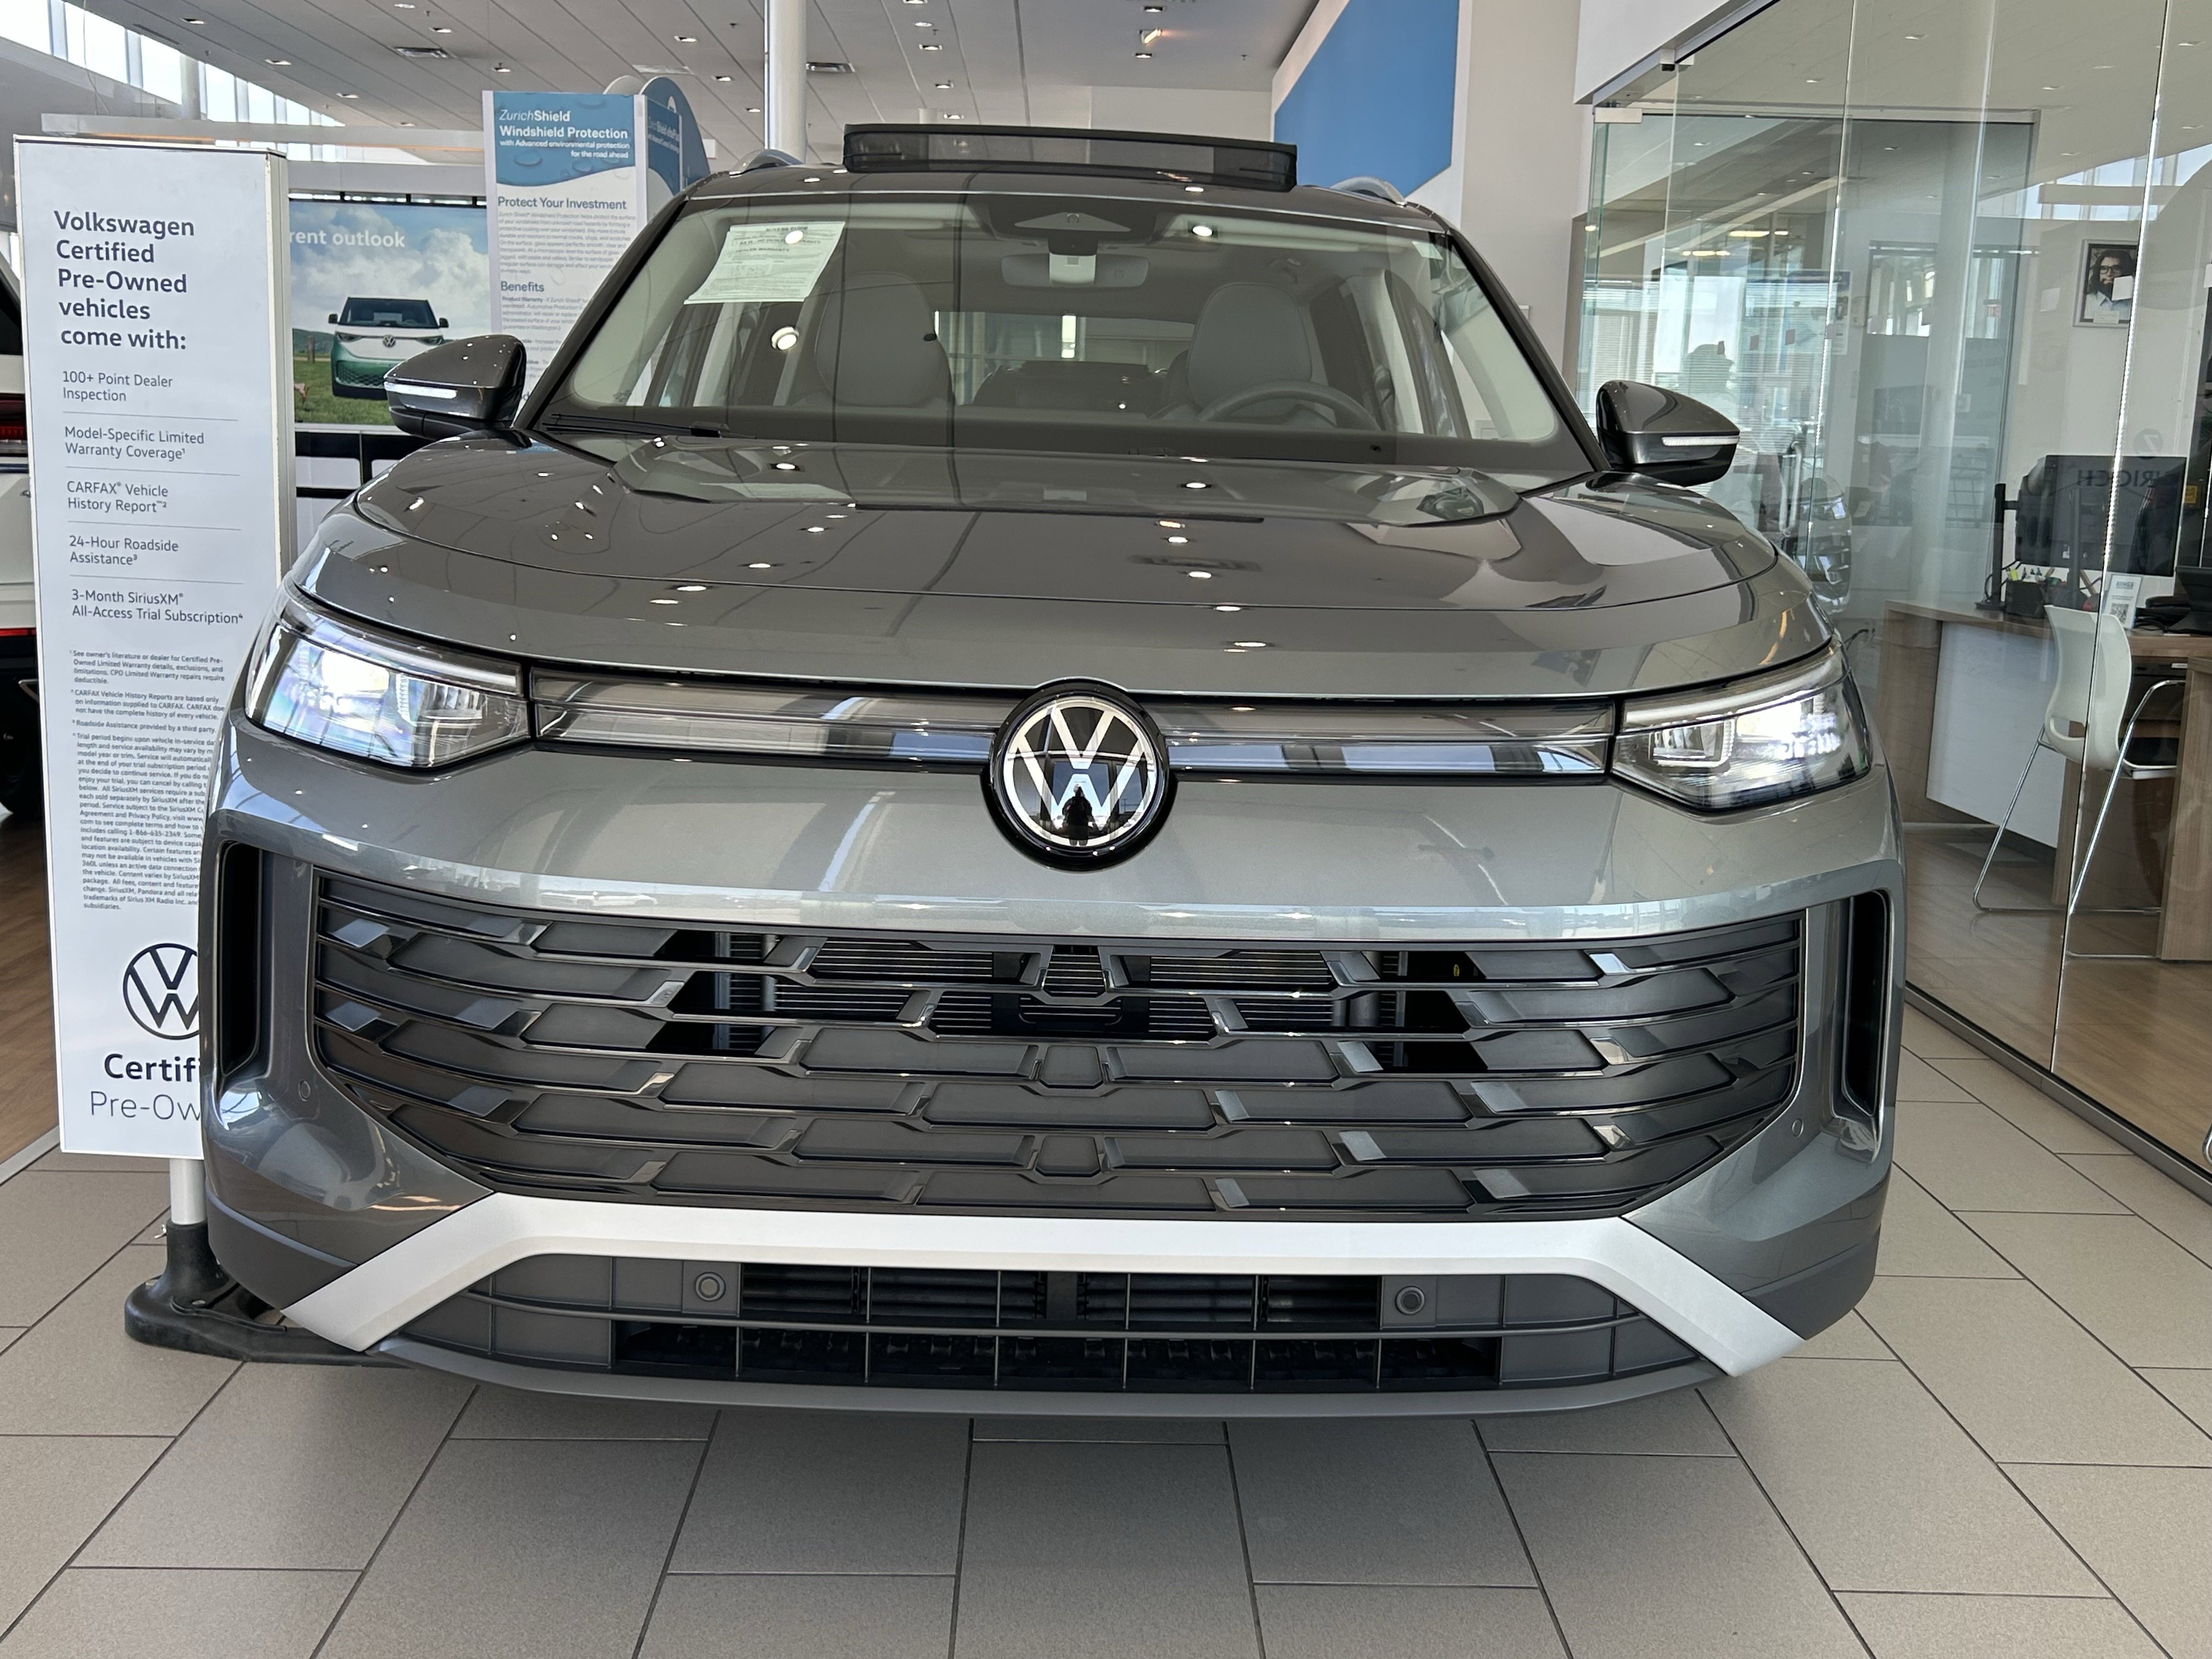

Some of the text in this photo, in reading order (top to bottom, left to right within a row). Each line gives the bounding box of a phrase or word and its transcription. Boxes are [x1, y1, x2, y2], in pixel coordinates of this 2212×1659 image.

[499, 110, 570, 122] ZurichShield
[500, 126, 628, 140] Windshield Protection
[515, 140, 548, 148] Advanced
[549, 141, 595, 149] environmental
[596, 142, 630, 150] protection
[498, 197, 627, 210] Protect Your Investment
[54, 211, 195, 239] Volkswagen
[333, 230, 405, 247] outlook
[56, 240, 154, 263] Certified
[59, 268, 187, 293] Pre-Owned
[501, 281, 544, 292] Benefits
[59, 298, 150, 319] vehicles
[61, 330, 185, 349] come with:
[63, 371, 172, 387] 100+ Point Dealer
[63, 387, 126, 402] Inspection
[65, 426, 204, 443] Model-Specific Limited
[65, 443, 121, 458] Warranty
[125, 484, 168, 496] Vehicle
[68, 497, 111, 512] History
[70, 535, 178, 551] 24-Hour Roadside
[72, 590, 123, 602] 3-Month
[72, 606, 132, 618] All-Access
[137, 608, 160, 619] Trial
[104, 1054, 199, 1082] Certif
